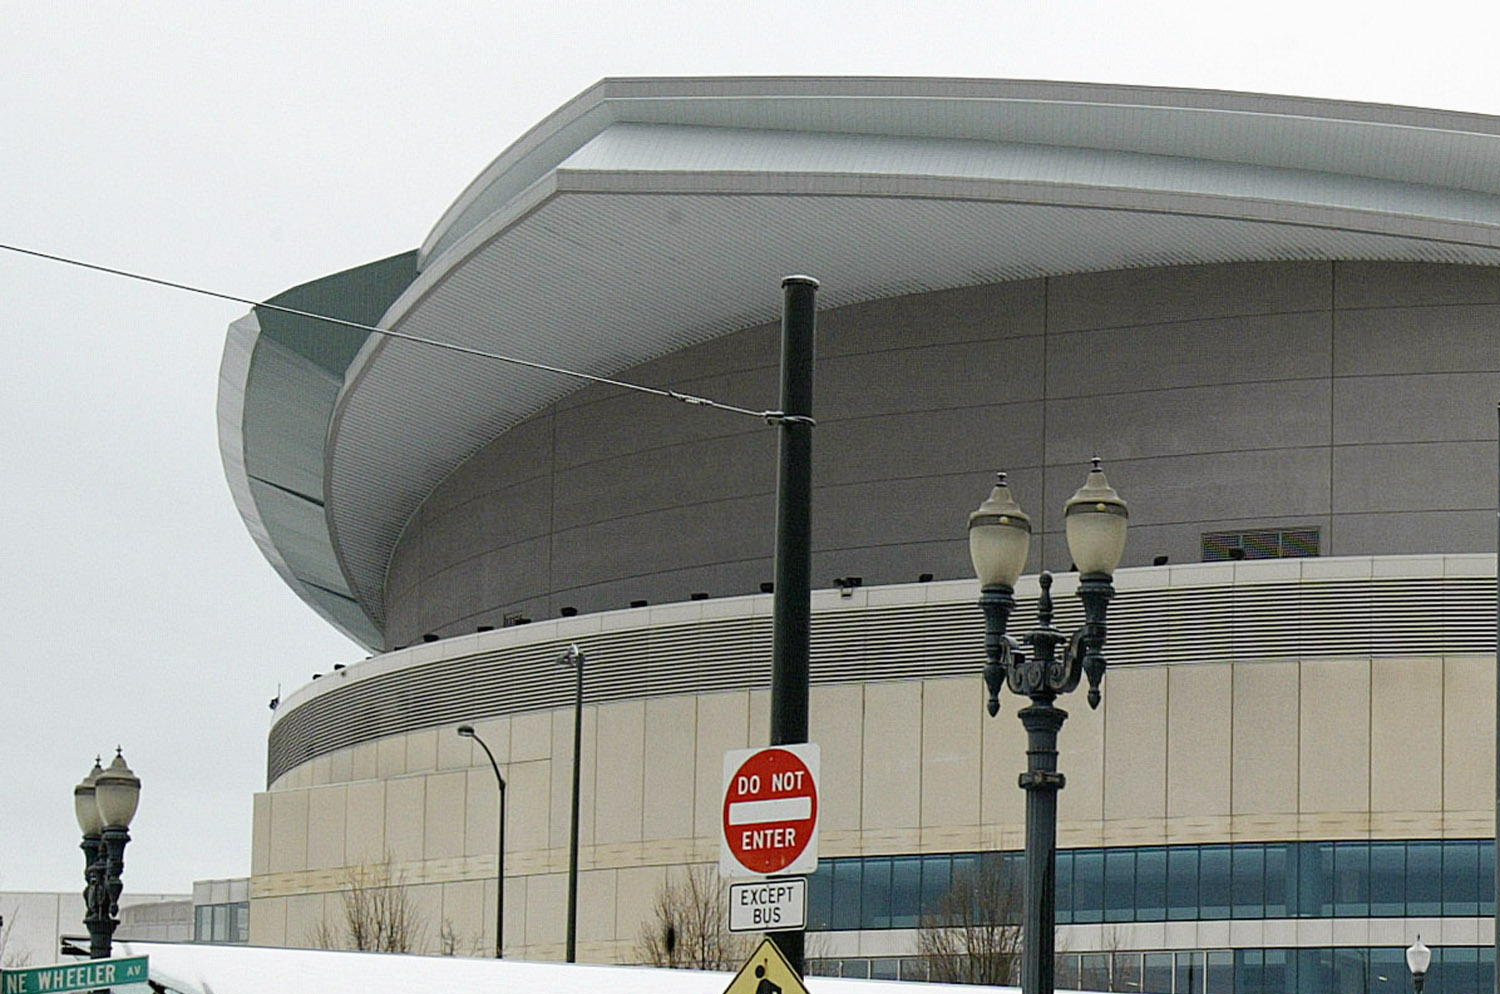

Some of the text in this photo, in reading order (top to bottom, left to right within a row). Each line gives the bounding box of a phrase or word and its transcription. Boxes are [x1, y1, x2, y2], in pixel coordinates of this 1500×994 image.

[738, 771, 804, 795] DO NOT
[742, 828, 796, 850] ENTER
[741, 886, 794, 905] EXCEPT
[753, 907, 781, 924] BUS
[7, 964, 142, 994] NE WHEELER AV
